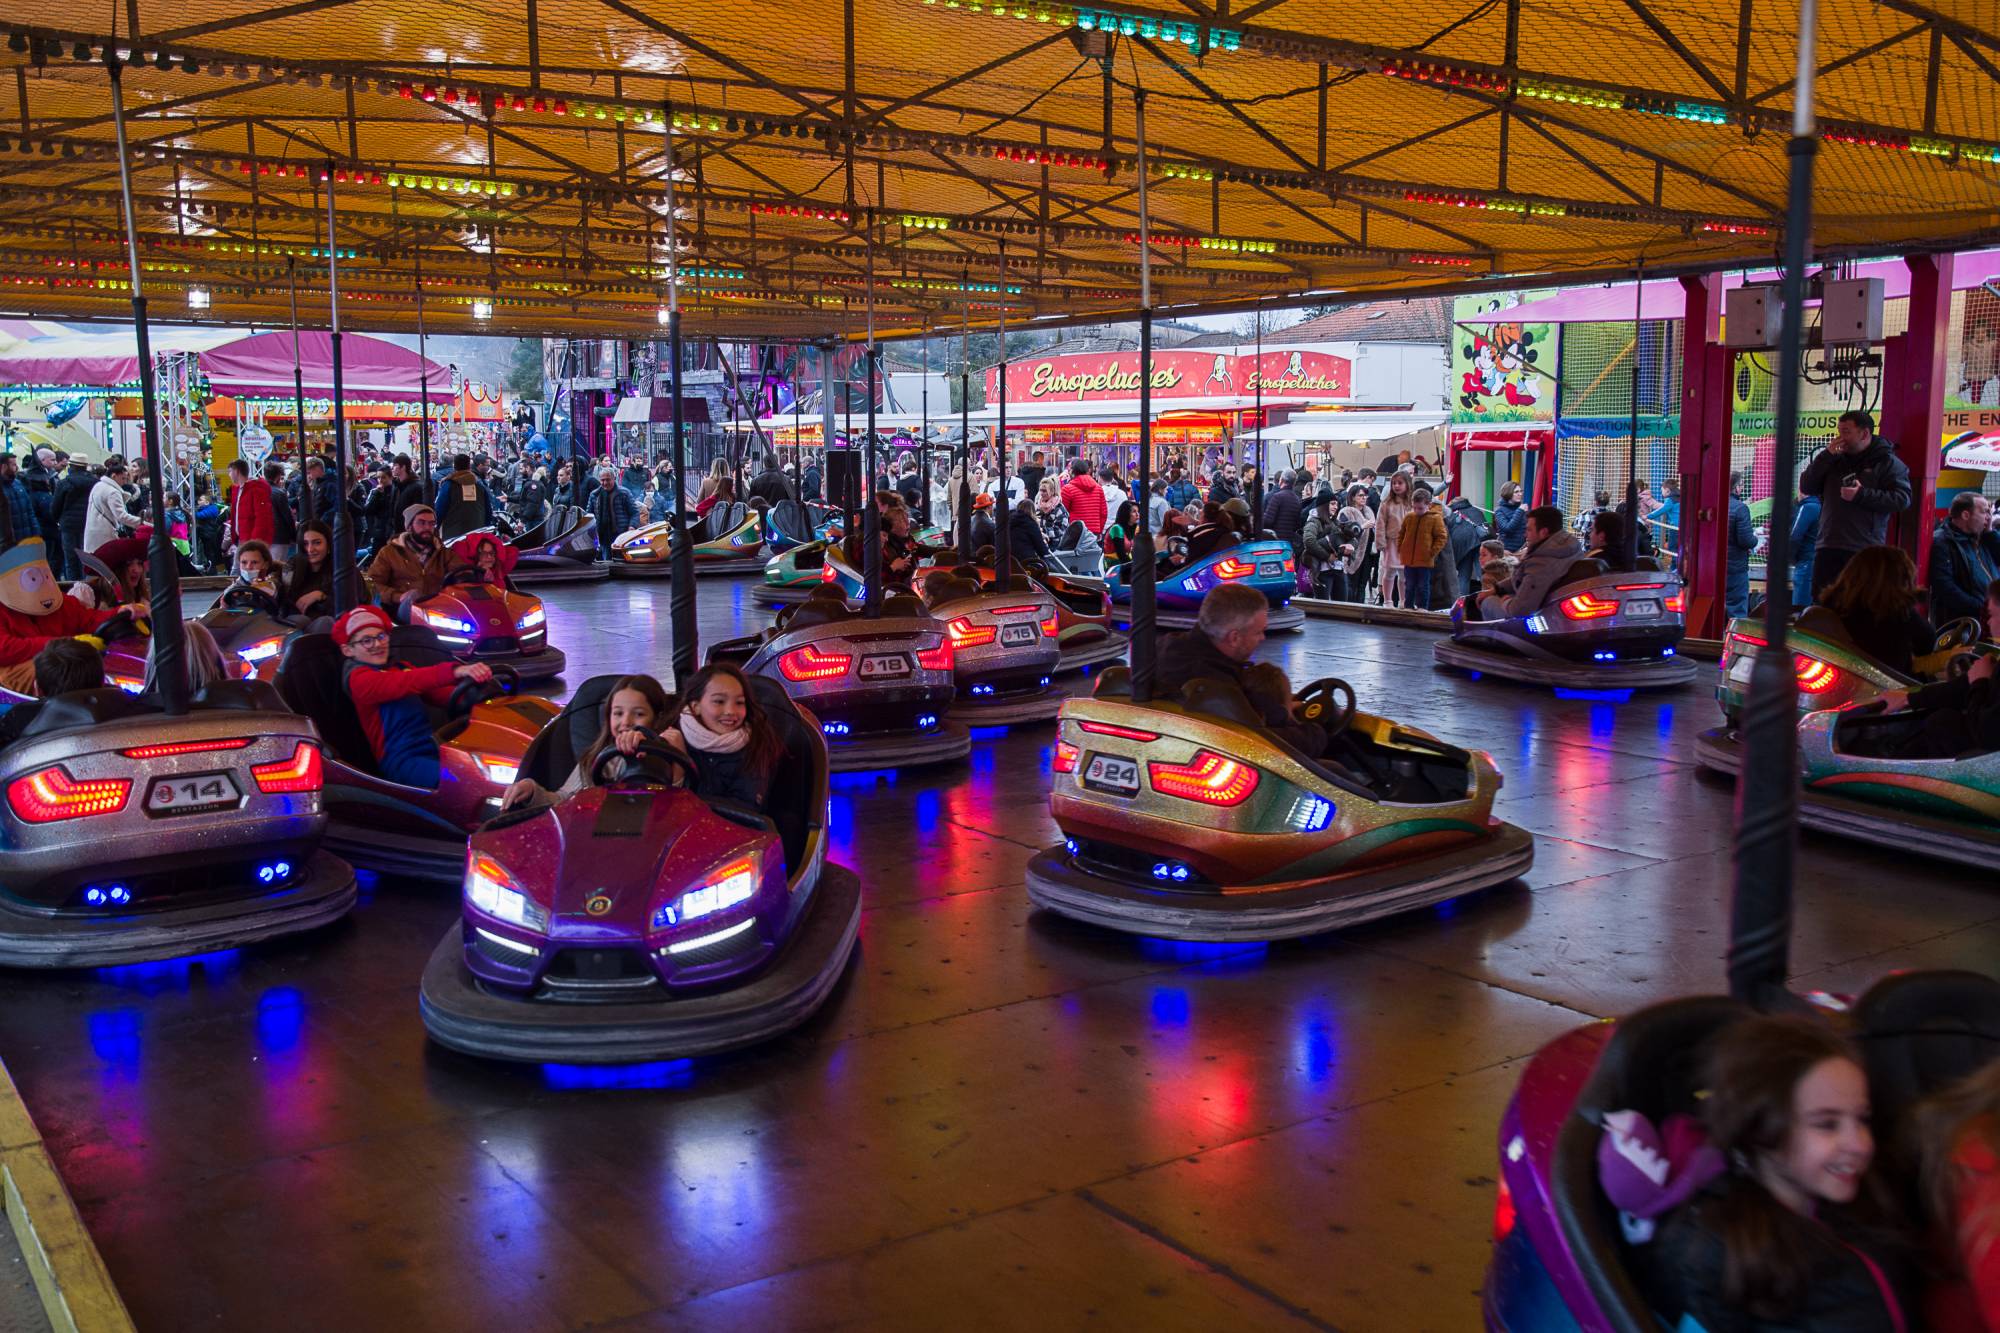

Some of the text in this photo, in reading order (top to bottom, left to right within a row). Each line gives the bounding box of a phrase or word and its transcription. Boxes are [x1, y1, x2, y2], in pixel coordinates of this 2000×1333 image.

[1245, 372, 1341, 396] Europeluches
[263, 403, 330, 416] FIETA
[1796, 416, 1838, 429] MOUS
[1636, 603, 1653, 613] 17
[877, 659, 902, 671] 18
[1104, 763, 1136, 785] 24
[180, 780, 225, 801] 14
